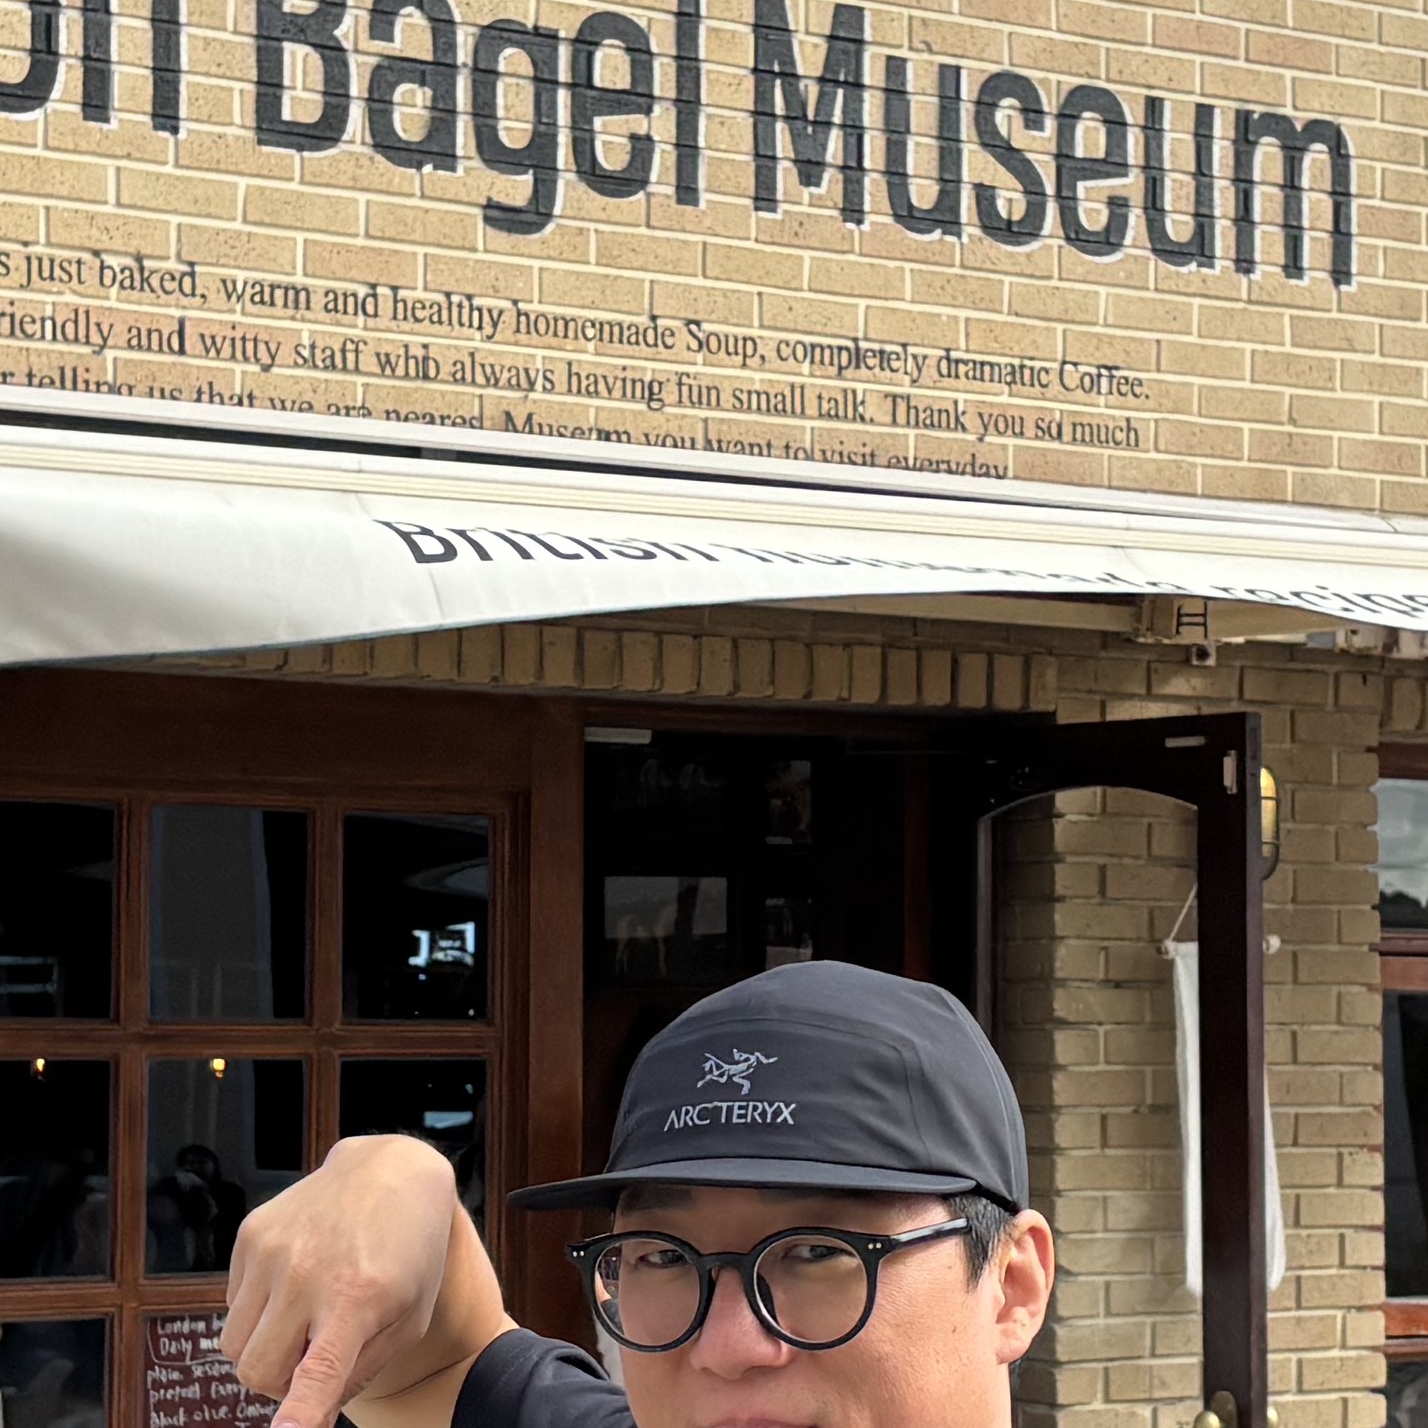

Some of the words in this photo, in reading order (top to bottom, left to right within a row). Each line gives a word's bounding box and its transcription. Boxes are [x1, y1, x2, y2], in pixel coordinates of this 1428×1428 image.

[20, 243, 86, 289] just
[92, 251, 208, 303] baked,
[220, 277, 311, 311] warm
[324, 284, 379, 318] and
[390, 288, 504, 341] healthy
[513, 301, 674, 350] homemade
[686, 320, 766, 365] Soup,
[776, 338, 927, 384] completely
[937, 349, 1049, 389] dramatic
[1059, 359, 1150, 401] Coffee.
[25, 369, 135, 397] telling
[196, 381, 255, 409] that
[126, 316, 186, 356] and
[199, 324, 281, 372] witty
[293, 337, 367, 373] staff
[376, 344, 440, 380] who
[452, 352, 556, 402] always
[566, 362, 665, 410] having
[675, 372, 722, 408] fun
[732, 383, 805, 417] small
[816, 388, 874, 425] talk.
[885, 393, 968, 431] Thank
[977, 408, 1024, 443] you
[1034, 413, 1062, 442] so
[1072, 417, 1140, 449] much
[372, 519, 719, 564] British
[157, 1315, 206, 1335] London
